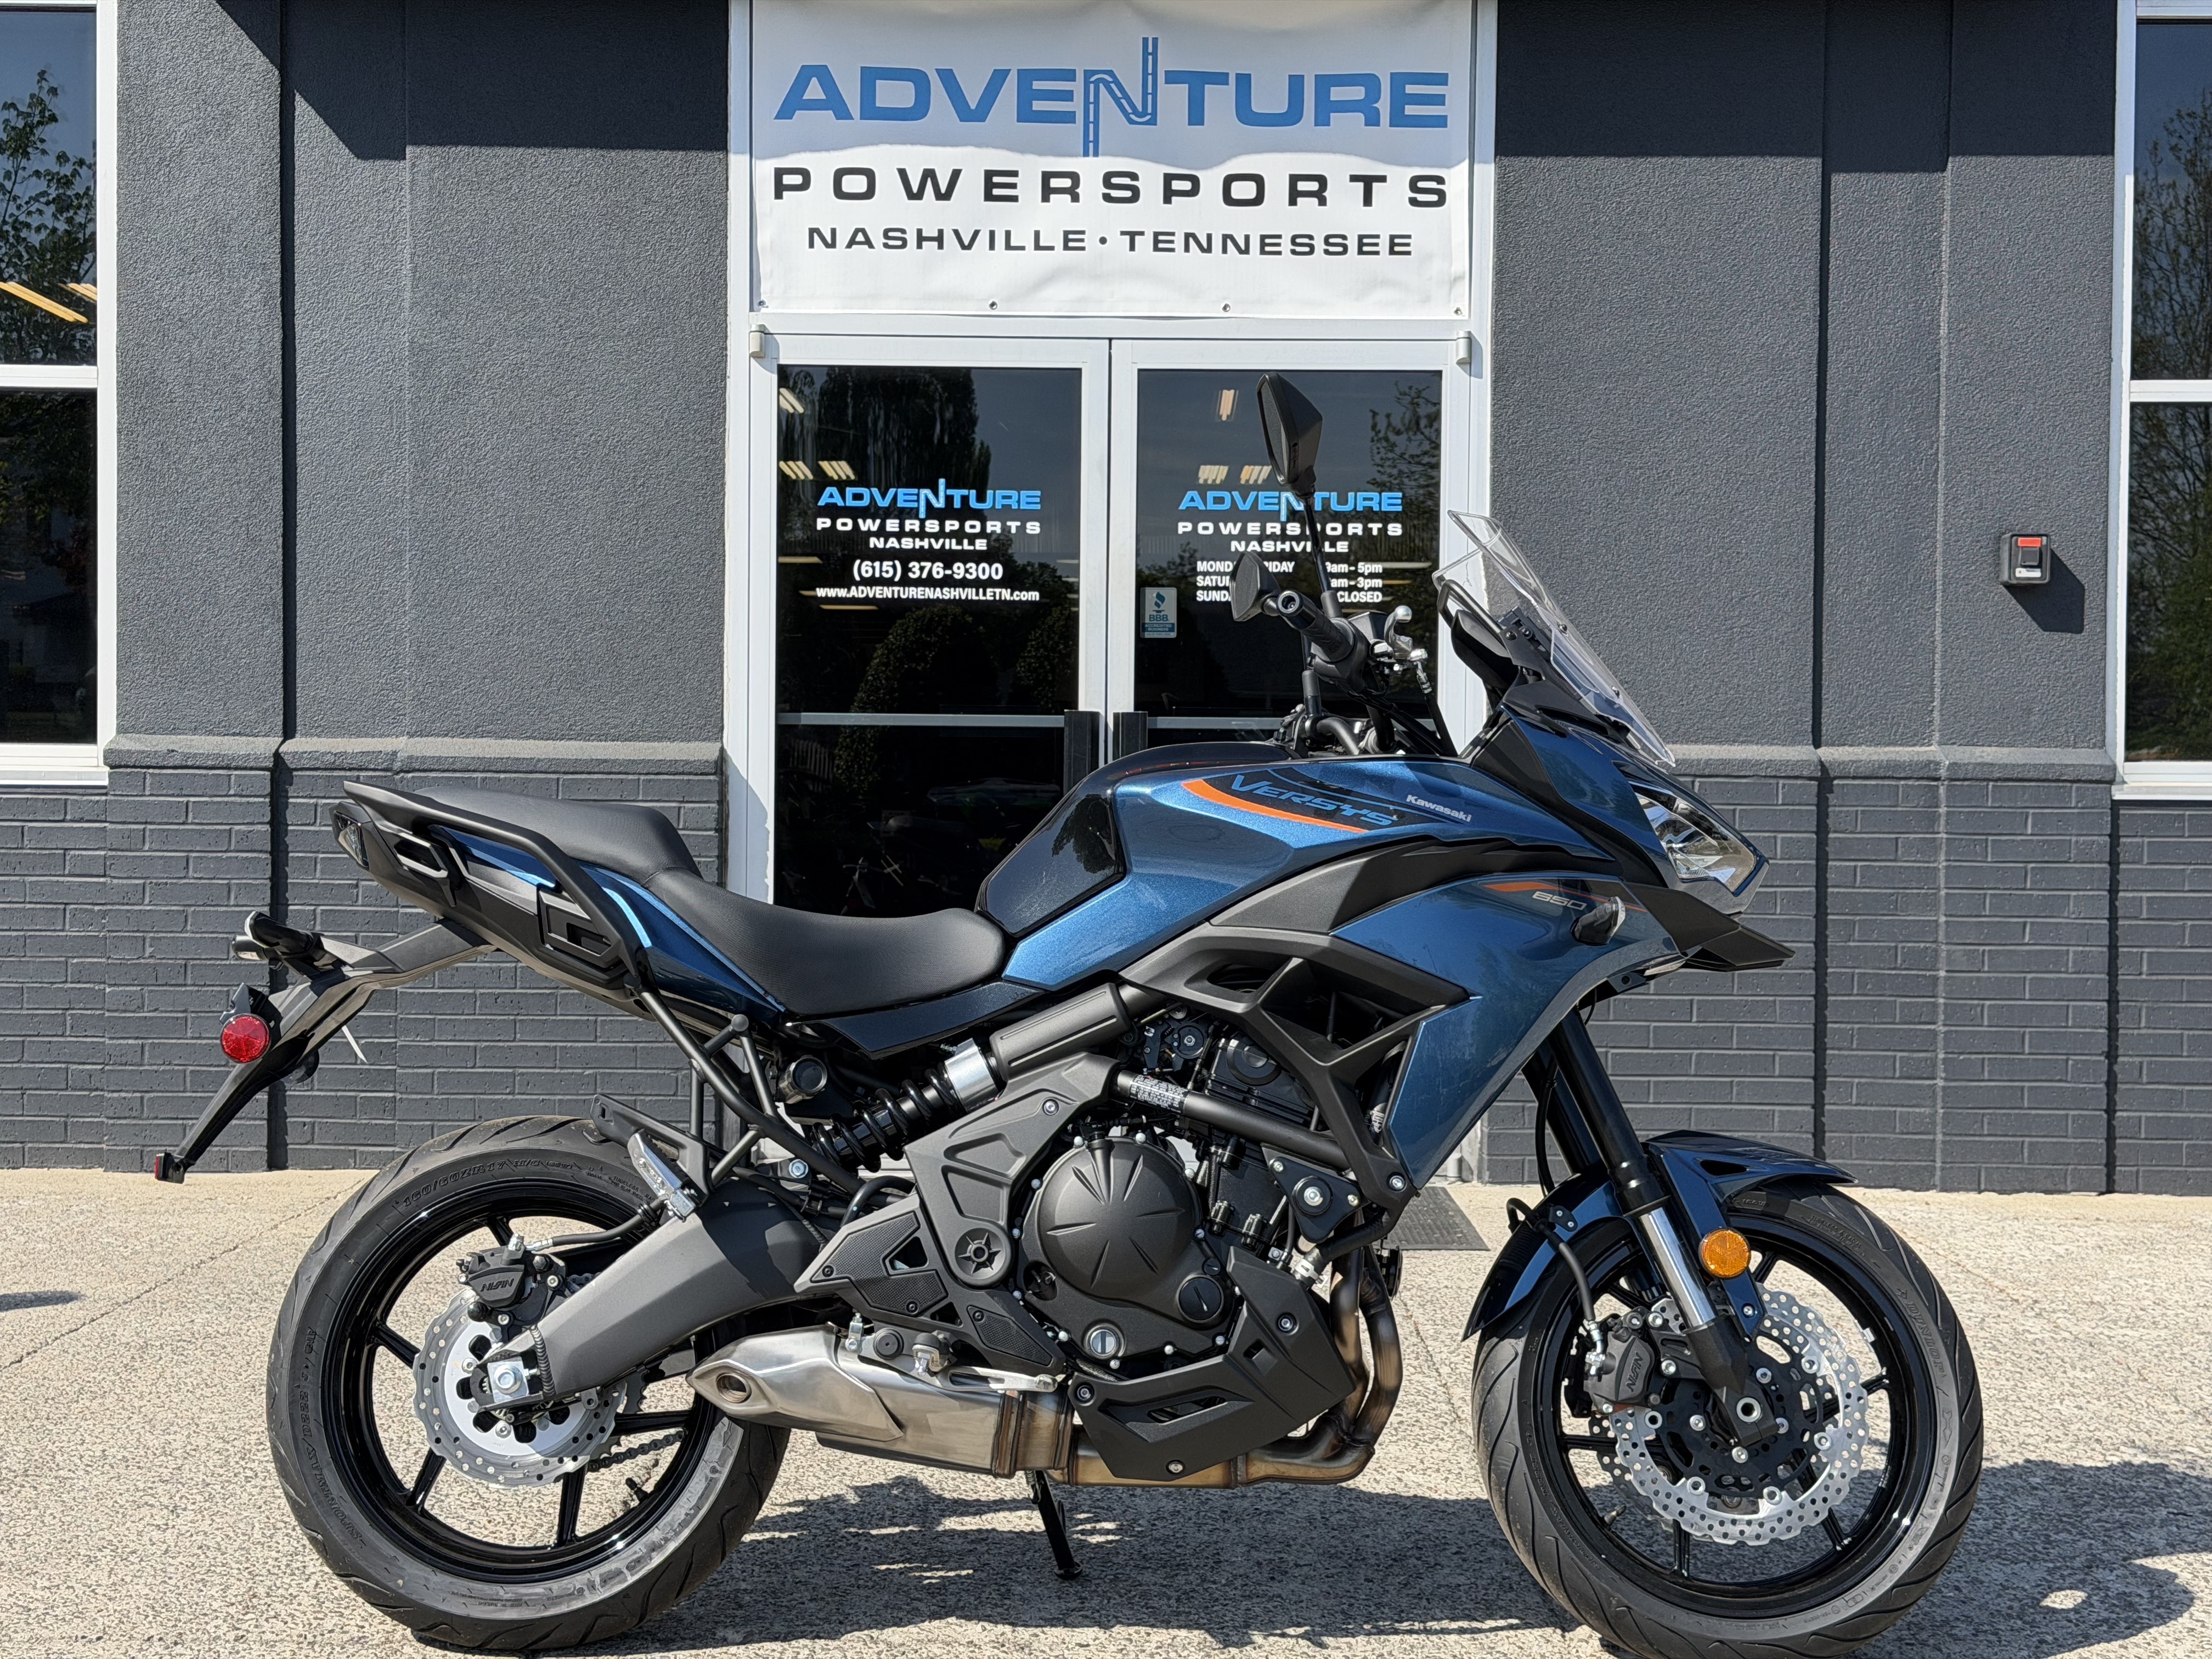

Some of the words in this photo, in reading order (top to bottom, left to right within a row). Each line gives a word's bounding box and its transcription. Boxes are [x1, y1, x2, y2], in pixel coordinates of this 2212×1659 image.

[774, 37, 1449, 157] ADVENTURE
[774, 167, 1447, 208] POWERSPORTS
[808, 227, 1087, 251] NASHVILLE
[1120, 230, 1413, 256] TENNESSEE
[817, 478, 1041, 518] ADVENTURE
[1178, 490, 1403, 522] ADVENTURE
[816, 517, 1041, 534] POWERSPORTS
[870, 537, 988, 550] NASHVILLE
[1231, 540, 1349, 552] NASHVILE
[853, 560, 901, 582] (615)
[908, 561, 1003, 580] 376-9300
[1197, 561, 1236, 573] MOND
[816, 585, 1040, 601] www.ADVENTURENASHVILLETN.com
[1329, 578, 1348, 588] am
[1197, 590, 1231, 602] SUND
[1336, 591, 1383, 602] CLOSED
[1231, 774, 1399, 826] VERSYS
[1406, 794, 1472, 823] Kawasaki
[1532, 891, 1587, 911] 650
